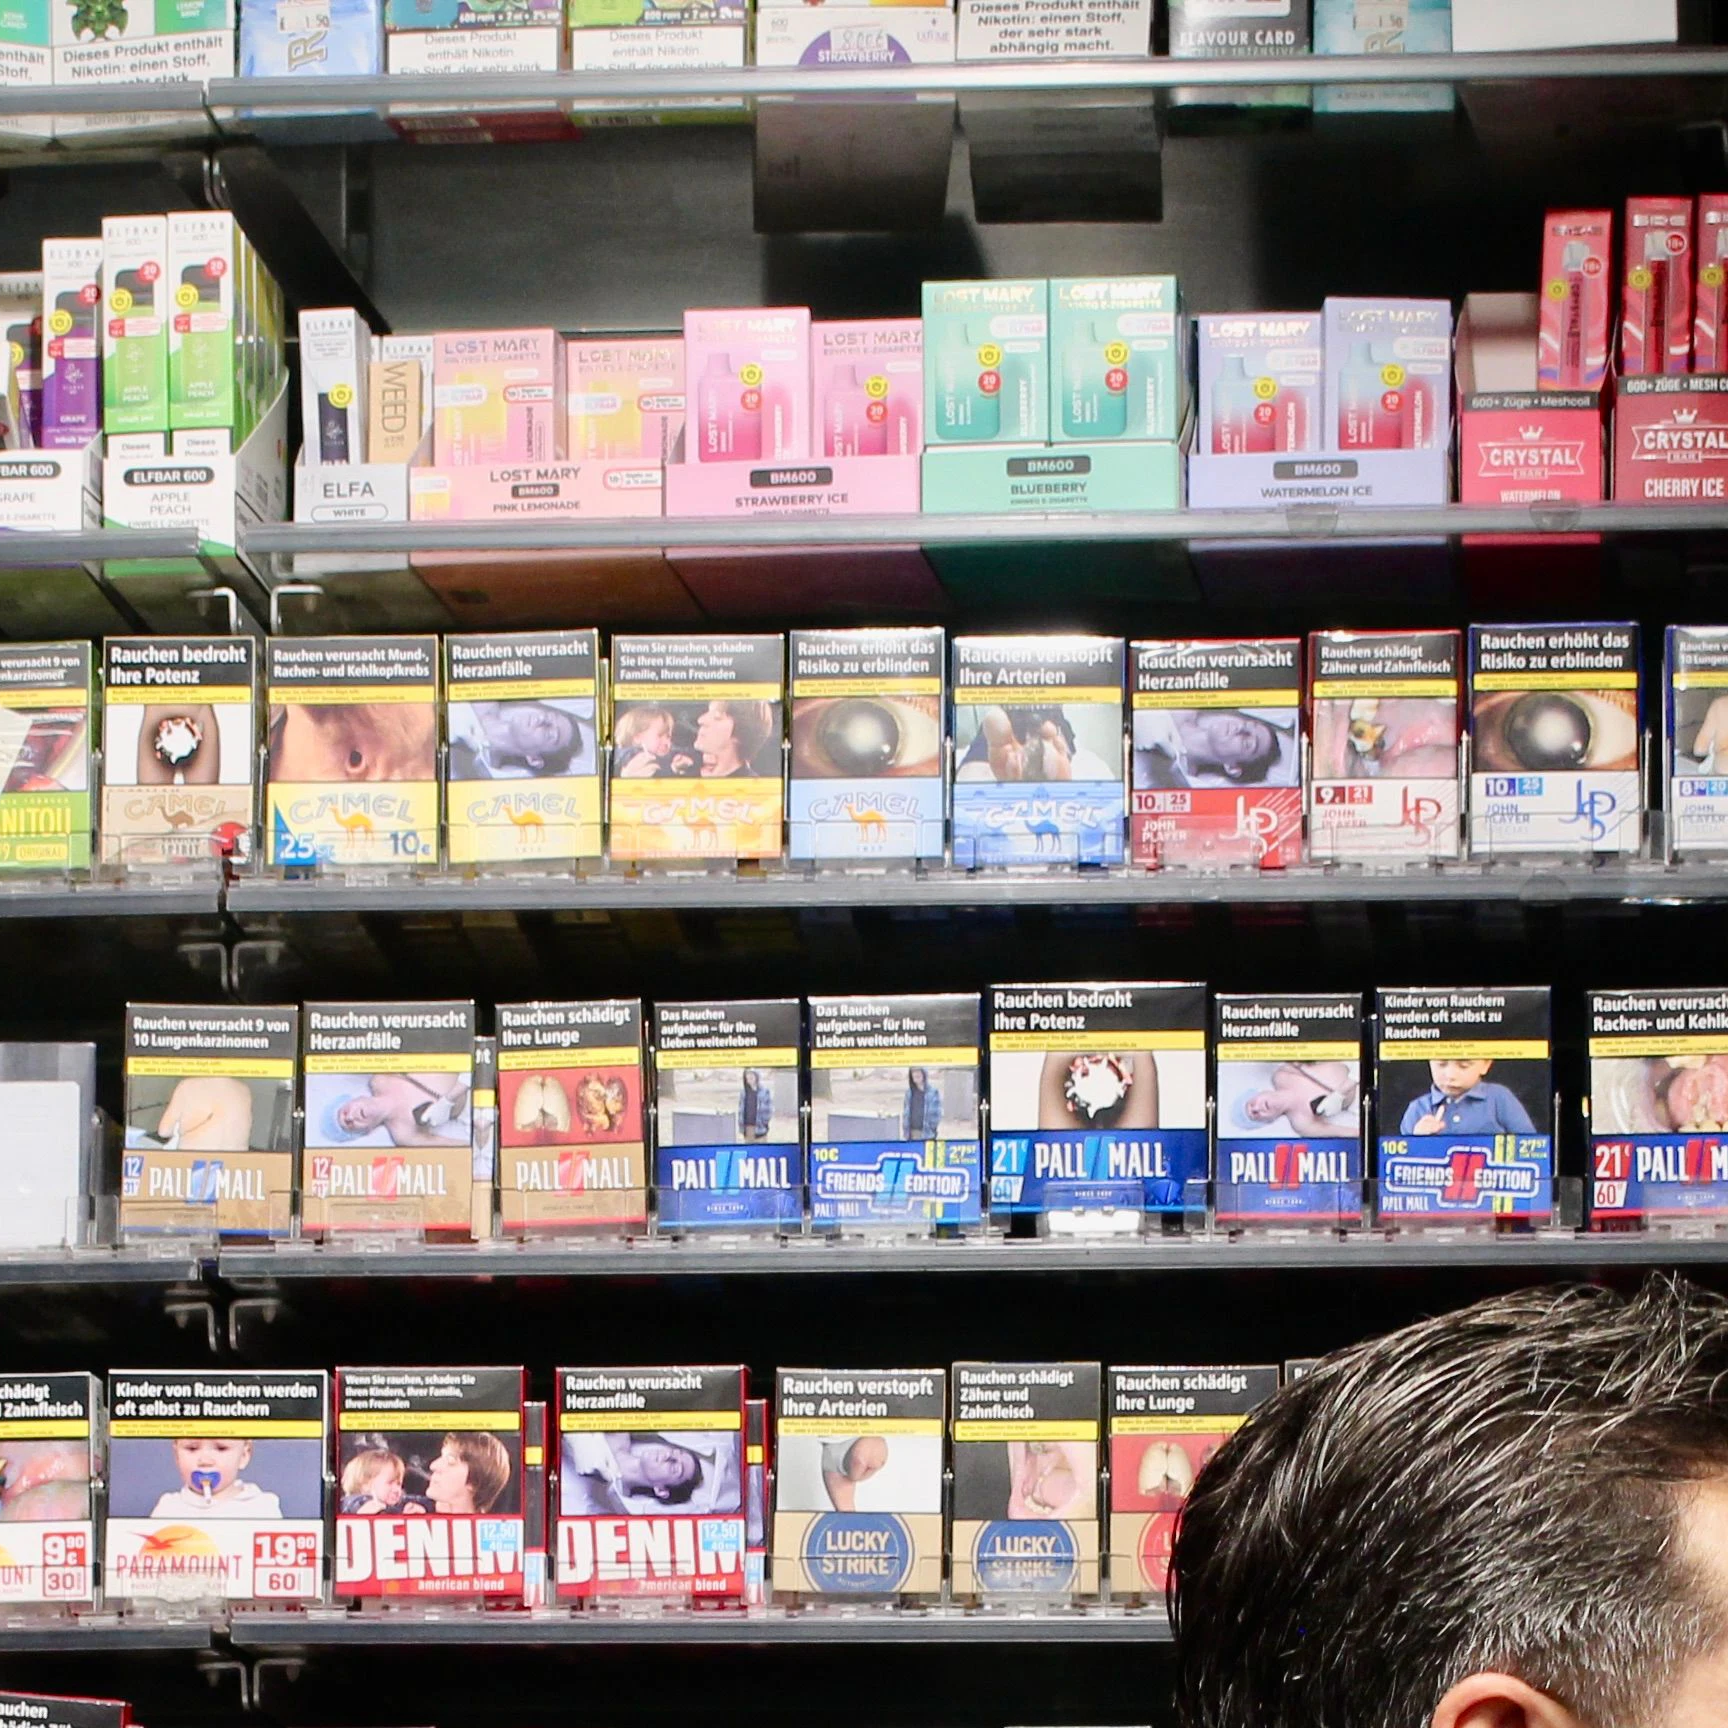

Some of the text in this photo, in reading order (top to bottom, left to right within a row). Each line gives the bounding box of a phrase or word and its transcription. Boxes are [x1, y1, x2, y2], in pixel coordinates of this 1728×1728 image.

[978, 12, 1125, 25] Nikotin: einen Stoff,
[999, 26, 1102, 39] der sehr stark
[1180, 30, 1295, 47] FLAVOUR CARD
[990, 39, 1114, 54] abhängig macht.
[818, 51, 895, 63] STRAWBERRY
[1690, 378, 1715, 393] MESH
[379, 361, 408, 433] WEED
[1643, 430, 1728, 451] CRYSTAL
[29, 462, 54, 478] 600
[1027, 458, 1075, 473] BM600
[132, 468, 206, 483] ELFBAR 600
[490, 467, 581, 483] LOST MARY
[769, 470, 817, 484] BM600
[323, 480, 374, 498] ELFA
[1010, 481, 1087, 496] BLUEBERRY
[1261, 484, 1372, 499] WATERMELON ICE
[1644, 478, 1724, 498] CHERRY ICE
[151, 491, 190, 505] APPLE
[735, 492, 849, 508] STRAWBERRY ICE
[149, 503, 192, 516] PEACH
[333, 508, 366, 518] WHITE
[493, 500, 581, 513] PINK LEMONADE
[453, 640, 588, 660] Rauchen verursacht
[453, 660, 532, 678] Herzanfälle
[1637, 1144, 1690, 1182] PALL
[1394, 1163, 1533, 1192] FRIENDS EDITION
[825, 1530, 890, 1553] LUCKY
[336, 1519, 524, 1582] DENIM
[822, 1554, 888, 1576] STRIKE
[419, 1577, 504, 1591] american blend
